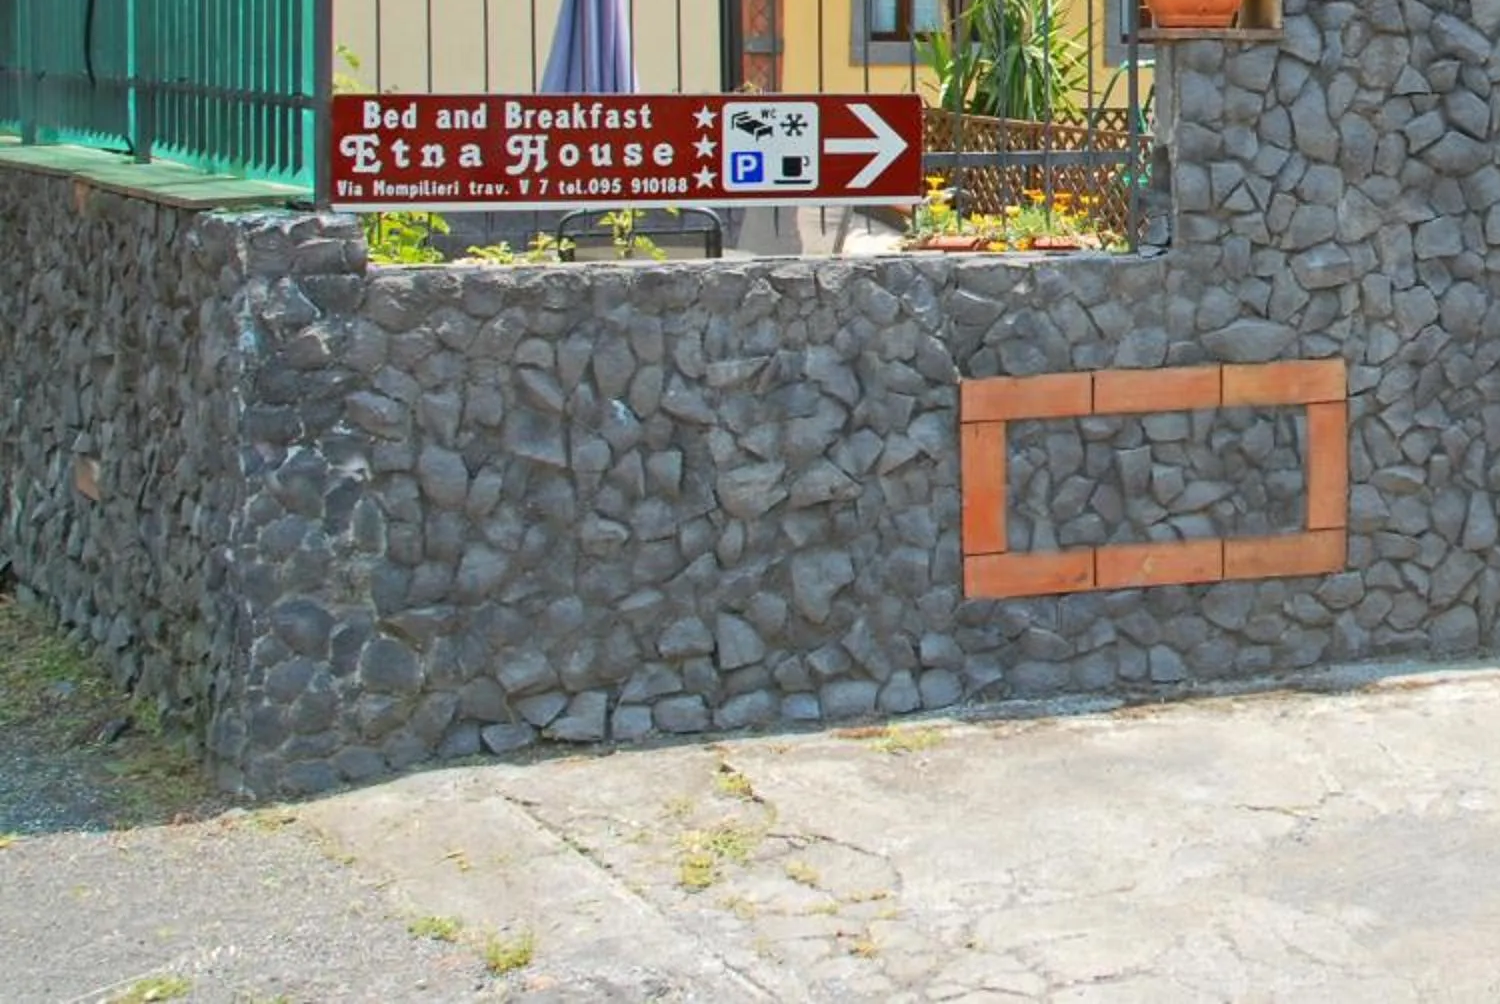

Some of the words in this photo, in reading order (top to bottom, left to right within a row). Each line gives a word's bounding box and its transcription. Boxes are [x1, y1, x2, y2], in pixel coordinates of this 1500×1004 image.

[363, 100, 417, 129] Bed
[436, 102, 487, 129] and
[505, 101, 652, 129] Breakfast
[761, 108, 776, 119] WC
[339, 133, 483, 173] Etna
[505, 134, 674, 175] House
[337, 180, 363, 196] Via
[469, 180, 510, 196] trav.
[539, 179, 549, 195] 7
[631, 177, 688, 194] 910188
